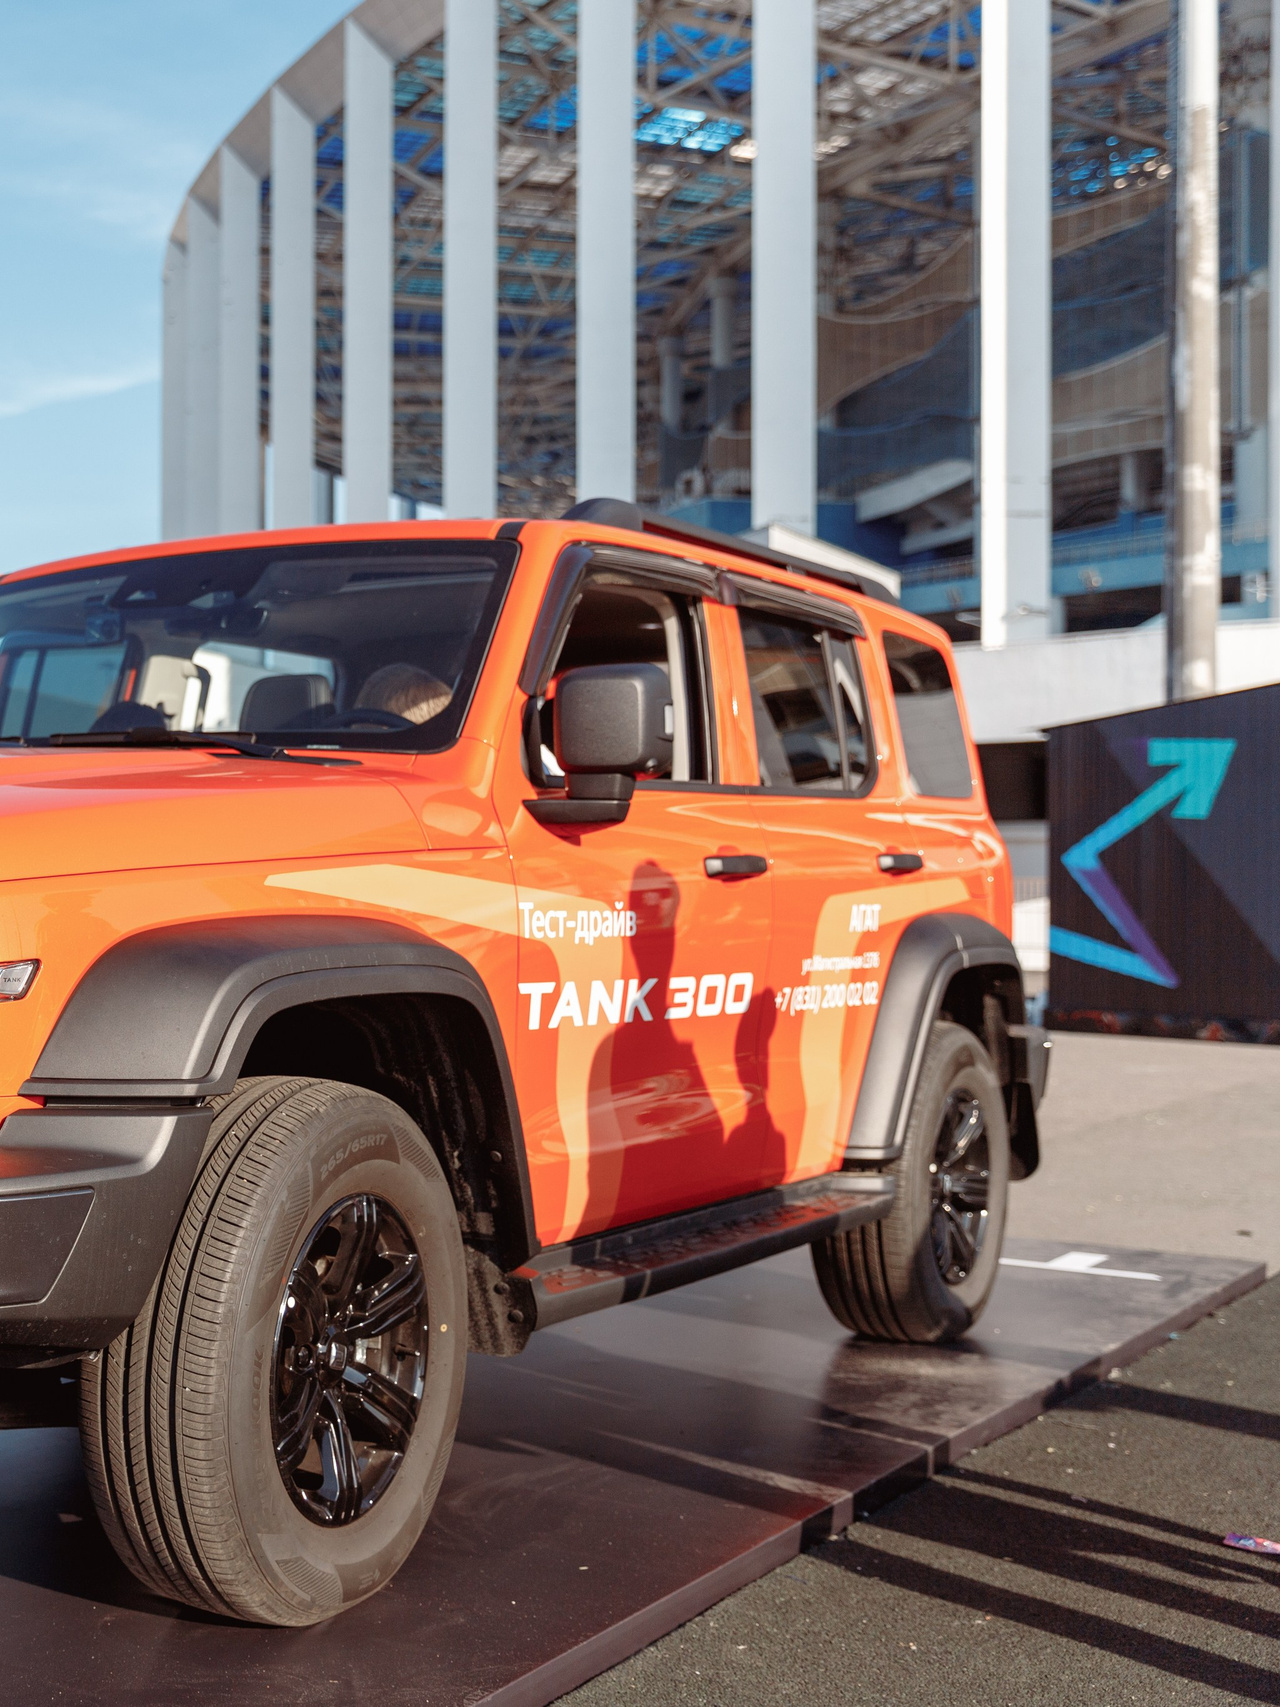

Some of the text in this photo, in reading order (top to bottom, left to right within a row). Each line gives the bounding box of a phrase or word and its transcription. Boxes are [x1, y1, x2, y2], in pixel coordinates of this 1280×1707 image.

[519, 901, 637, 946] Тест-драйв
[849, 903, 881, 933] АГАТ
[518, 972, 754, 1031] TANK 300
[775, 980, 880, 1017] +7 (831) 200 02 02
[320, 1133, 389, 1182] 265/65R17
